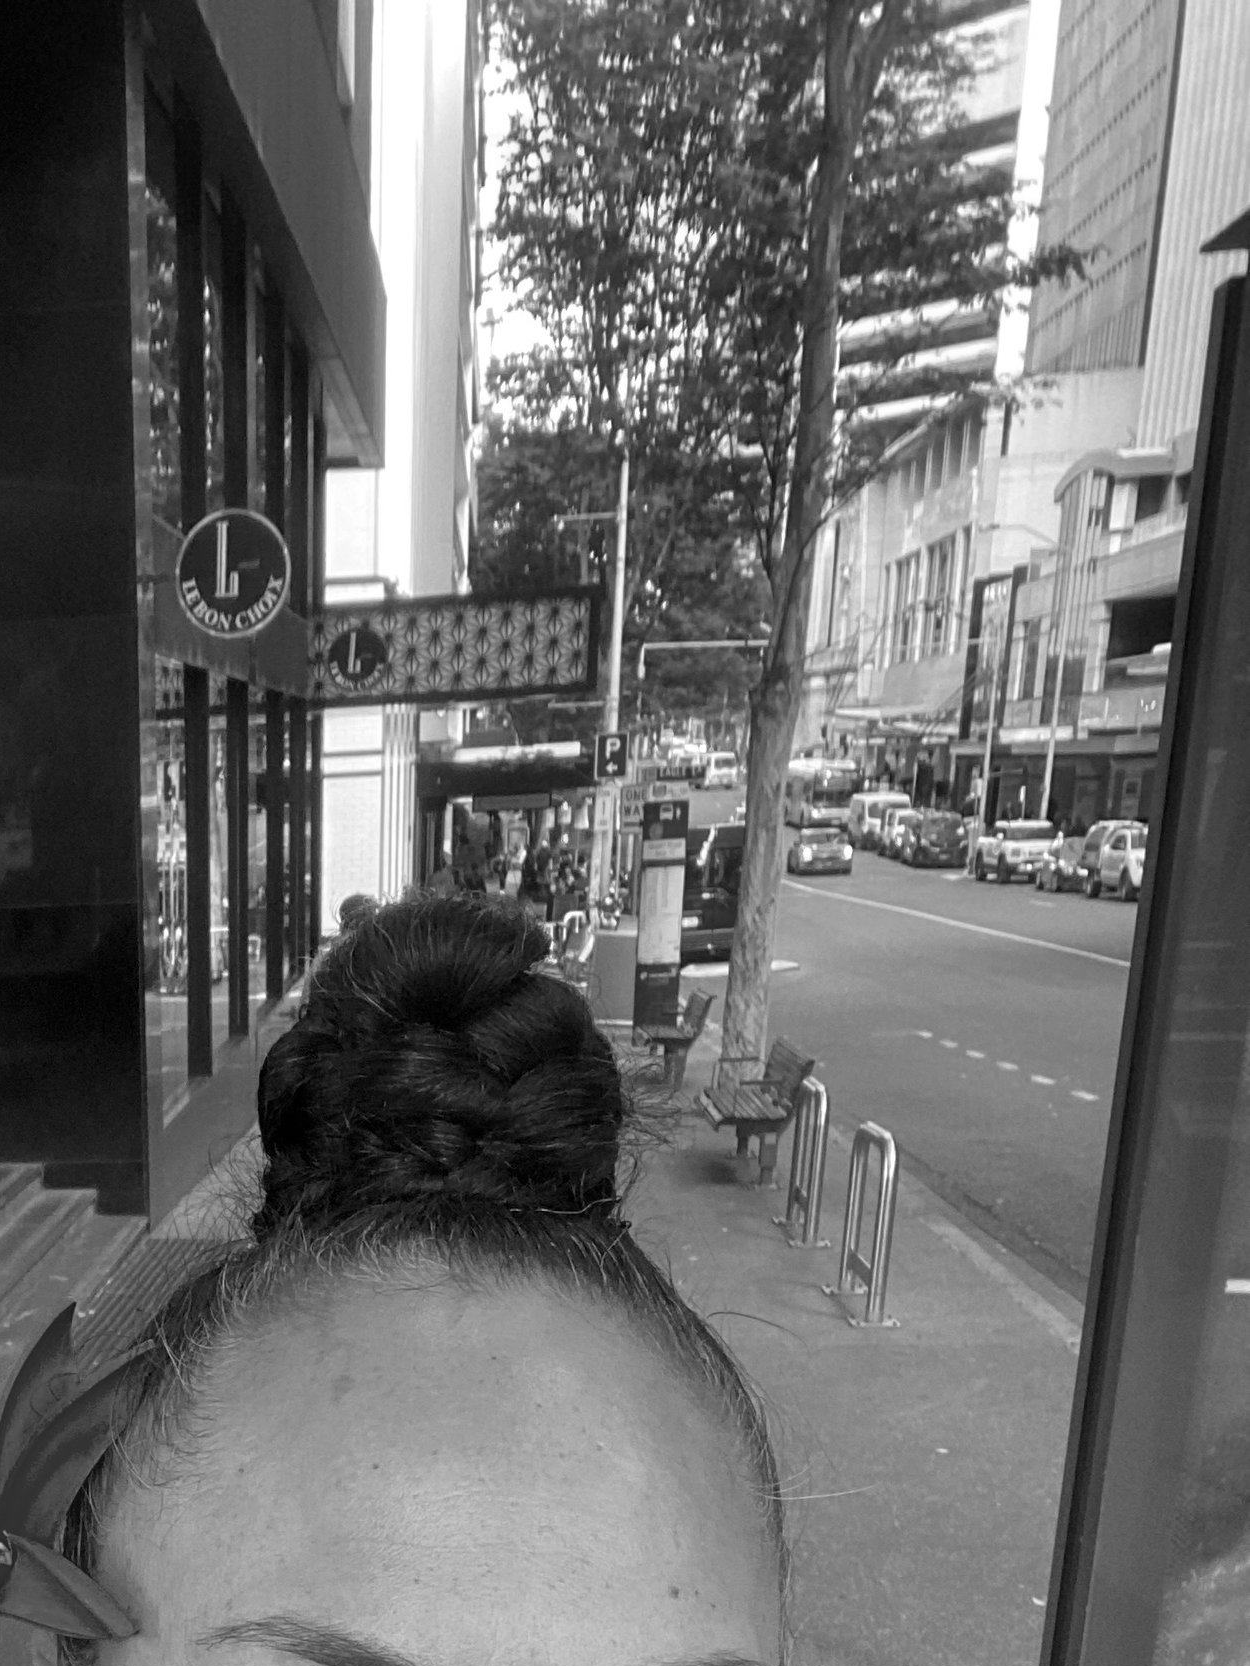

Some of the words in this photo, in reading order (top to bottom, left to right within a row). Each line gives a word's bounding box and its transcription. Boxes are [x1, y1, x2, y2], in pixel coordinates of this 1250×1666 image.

[182, 576, 201, 607] LE
[193, 598, 232, 631] BON
[235, 573, 284, 630] CHOIX
[605, 738, 621, 760] P
[626, 788, 649, 801] ONE
[623, 804, 643, 817] WA
